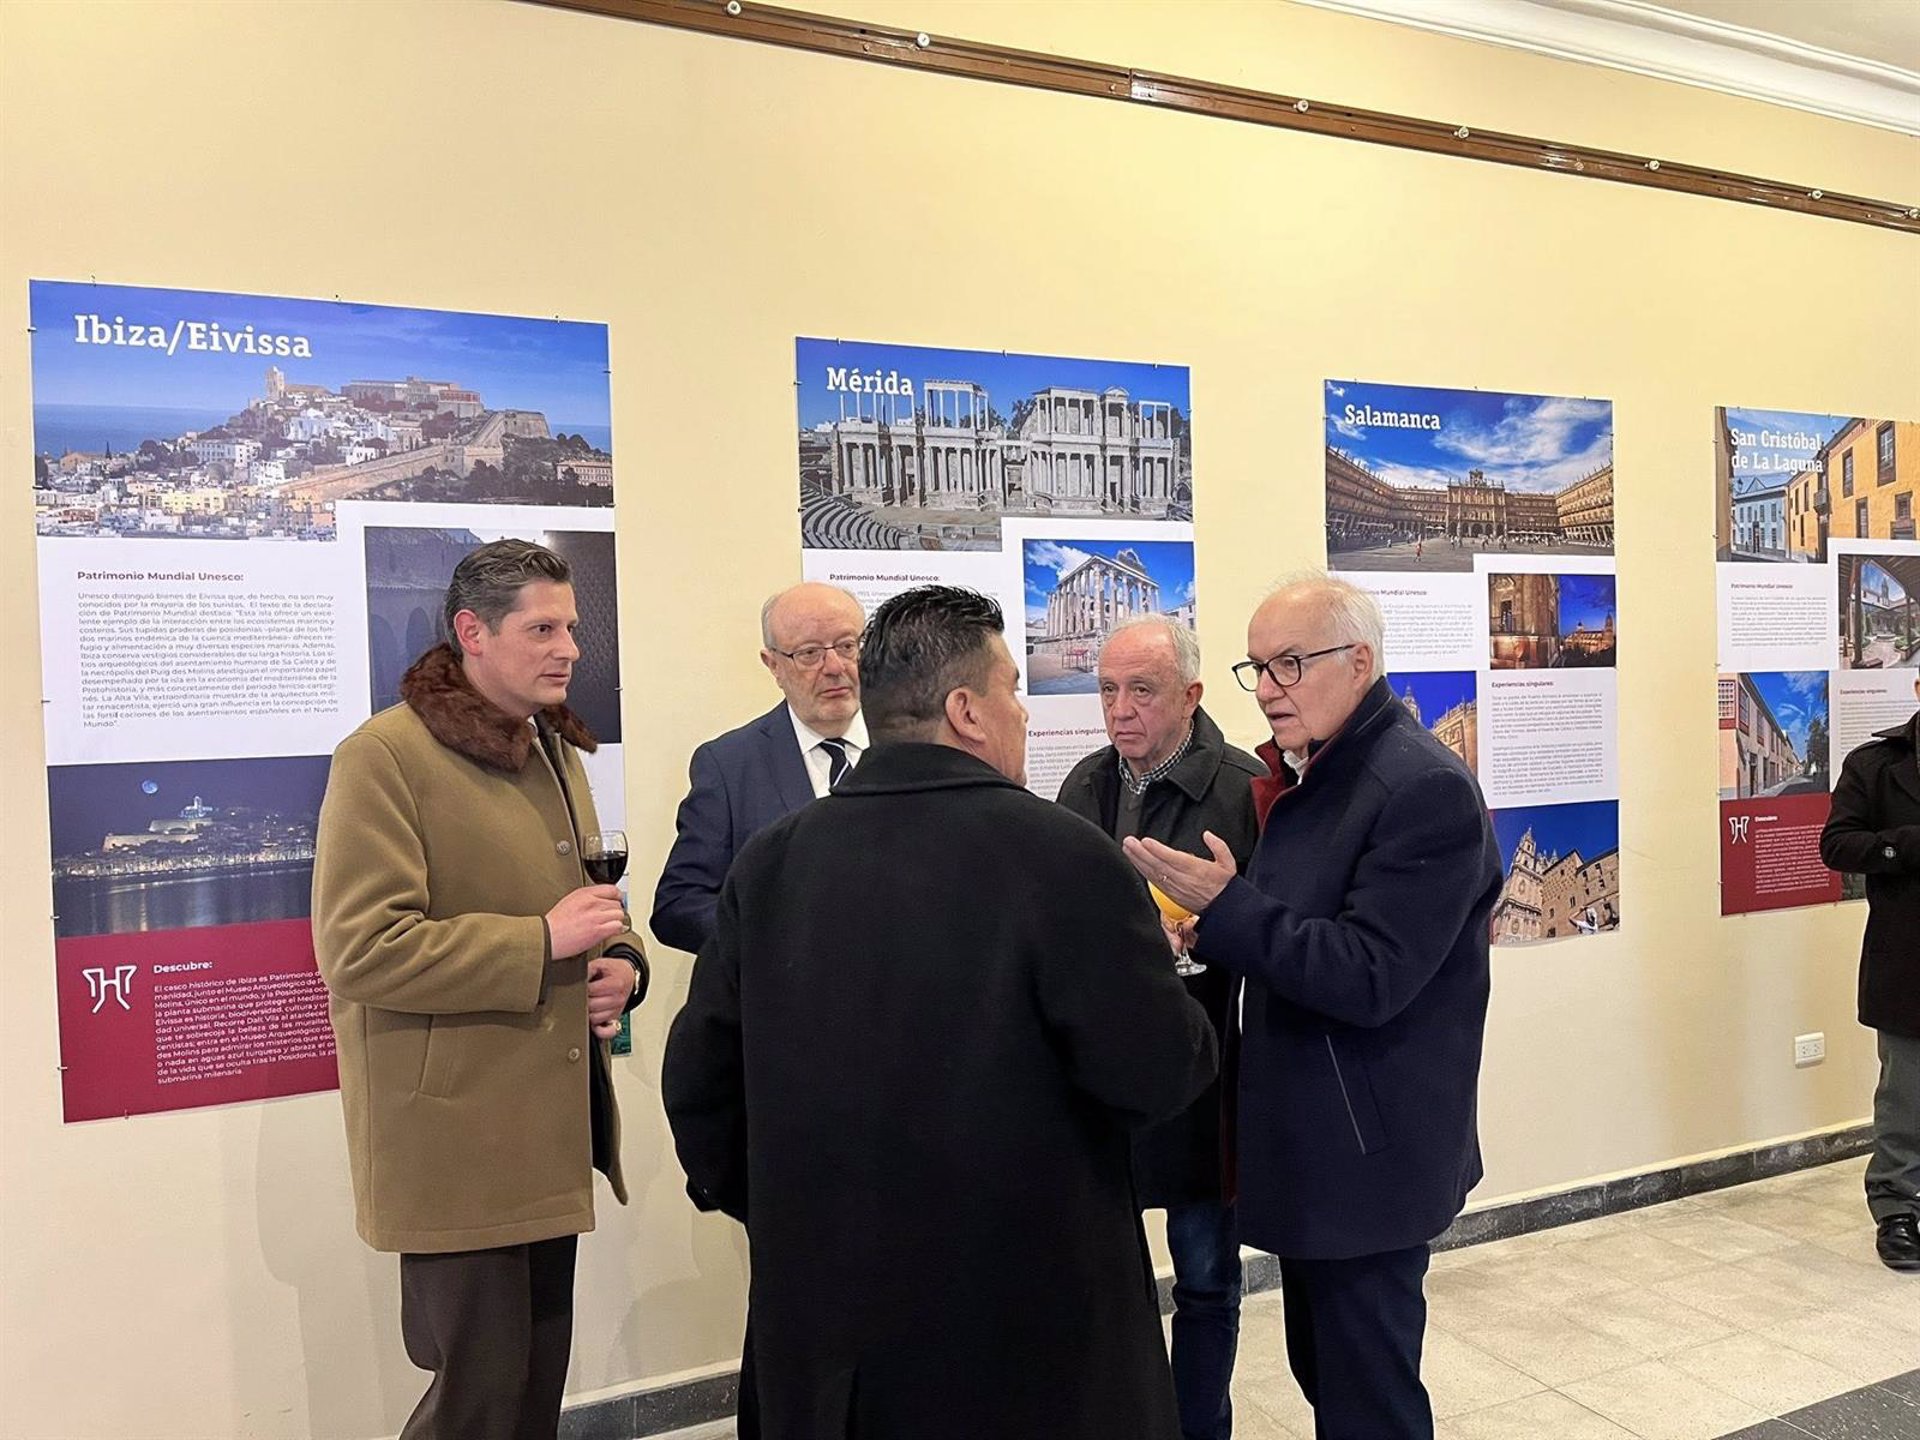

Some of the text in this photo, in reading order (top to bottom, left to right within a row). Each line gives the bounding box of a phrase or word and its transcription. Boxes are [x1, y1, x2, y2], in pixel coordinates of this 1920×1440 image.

[74, 314, 312, 357] Ibiza/Eivissa
[826, 366, 914, 396] Mérida
[1344, 403, 1441, 430] Salamanca
[1731, 428, 1821, 450] San Cristóbal
[1731, 450, 1824, 475] de La Laguna
[77, 571, 244, 581] Patrimonio Mundial Unesco:
[876, 574, 908, 582] Mundial
[910, 574, 941, 582] Unesco:
[1028, 727, 1107, 737] Experiencias singulare
[153, 961, 213, 974] Descubre:
